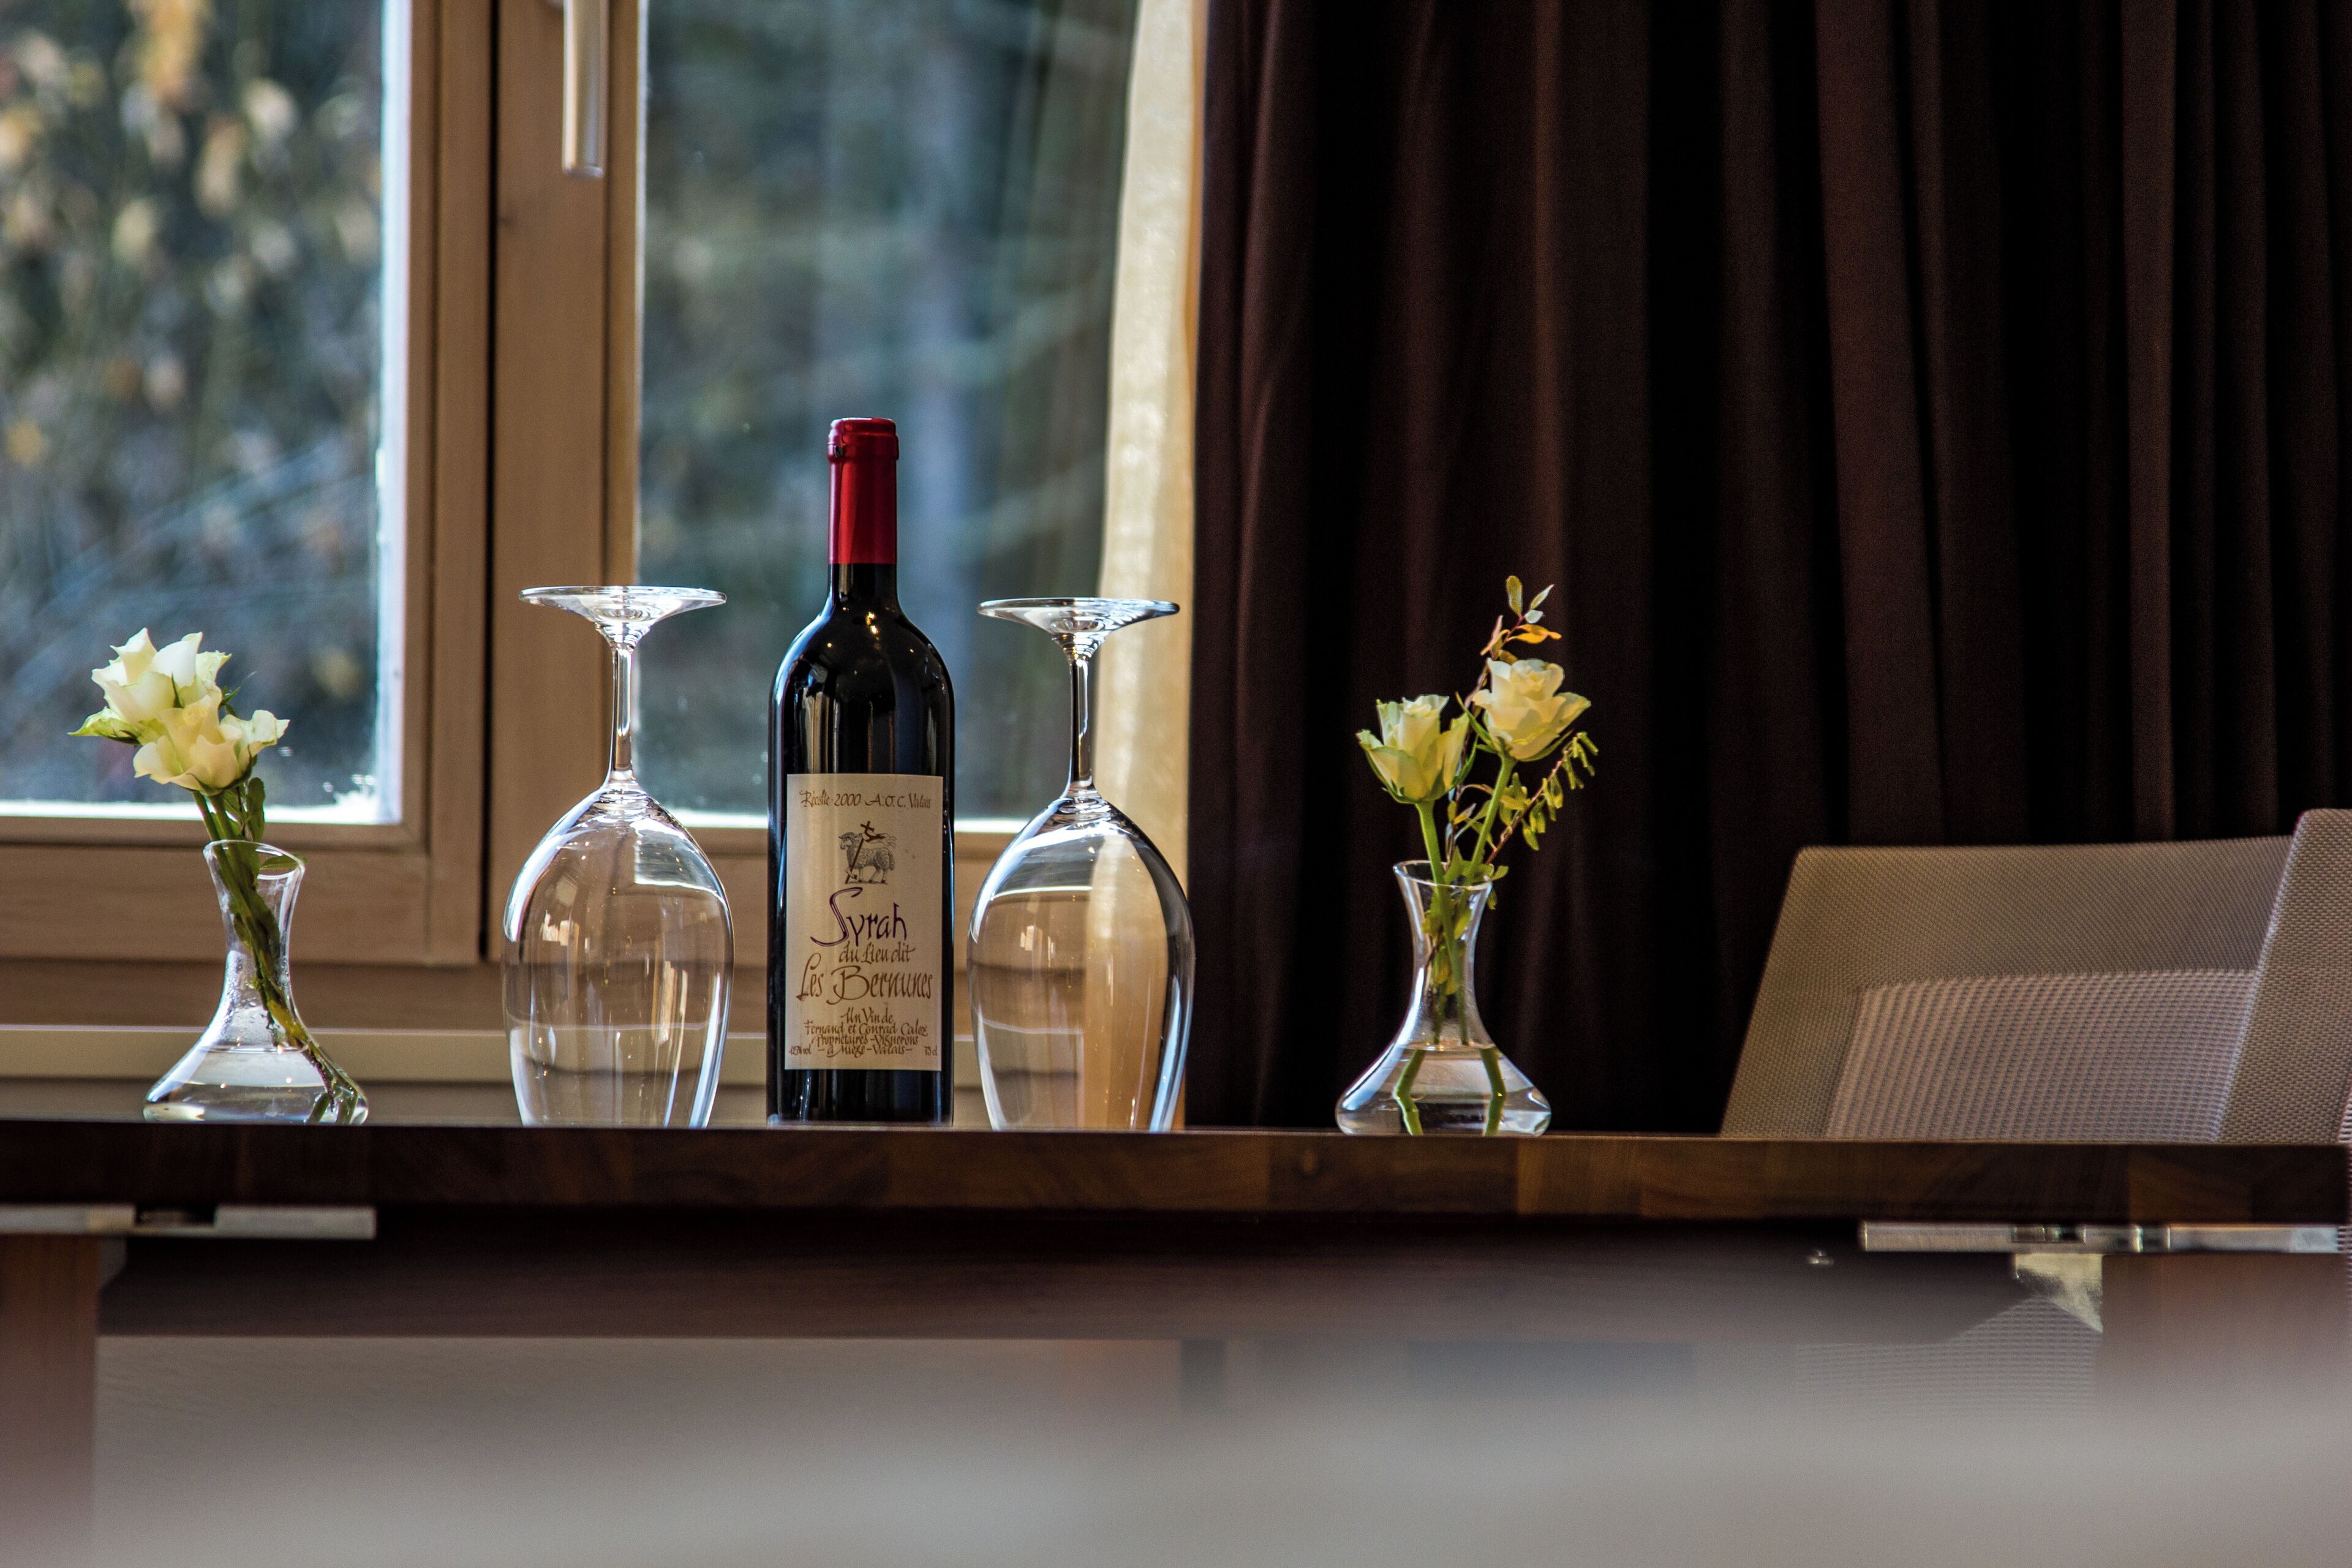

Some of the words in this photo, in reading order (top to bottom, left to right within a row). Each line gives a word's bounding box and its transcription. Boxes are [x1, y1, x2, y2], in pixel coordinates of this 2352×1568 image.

[834, 793, 861, 806] 2000
[810, 886, 907, 947] Syrah
[839, 941, 859, 963] du
[861, 941, 888, 965] Lieu
[890, 941, 916, 963] dit
[796, 952, 824, 1001] Les
[826, 965, 933, 1005] Bernunes
[840, 1007, 861, 1023] Un
[861, 1006, 880, 1024] Vin
[881, 1007, 893, 1024] de
[804, 1019, 843, 1035] Fernand
[848, 1023, 856, 1035] et
[859, 1022, 897, 1035] Conrad
